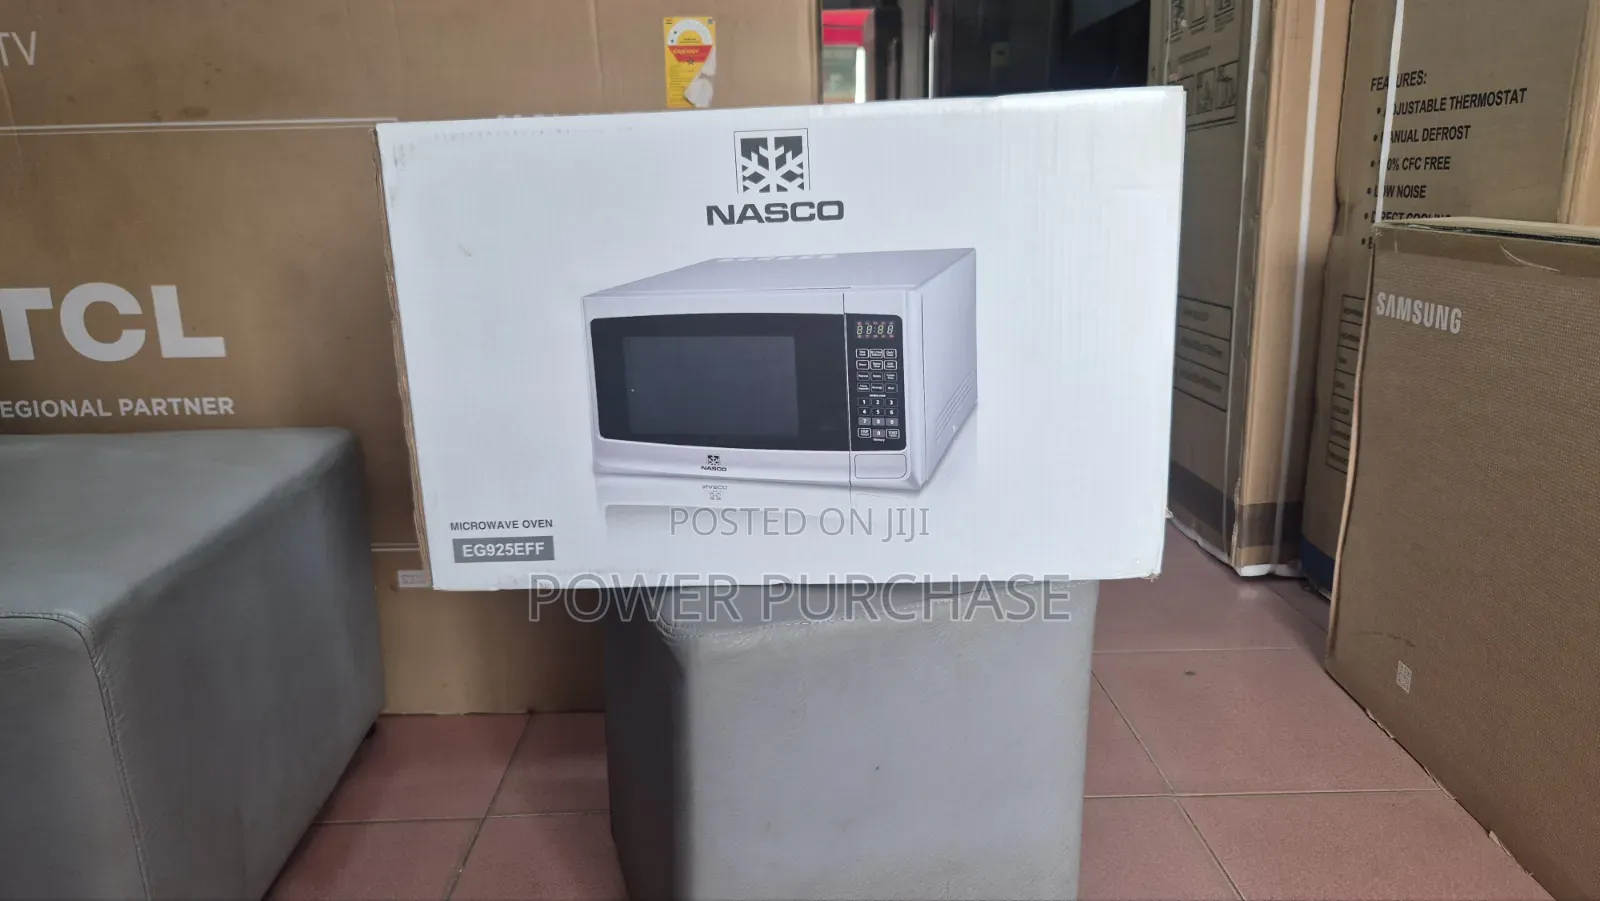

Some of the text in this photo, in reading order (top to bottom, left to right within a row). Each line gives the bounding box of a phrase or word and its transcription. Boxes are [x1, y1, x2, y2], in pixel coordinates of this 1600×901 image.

[1370, 70, 1427, 92] FEAURES:
[1450, 88, 1527, 111] THERMOSTAT
[1421, 125, 1471, 142] DEFROST
[1402, 157, 1422, 171] CFC
[1423, 156, 1451, 171] FREE
[1396, 185, 1426, 198] NOISE
[706, 200, 845, 226] NASCO
[0, 282, 226, 362] TCL
[1376, 292, 1462, 334] SAMSUNG
[118, 397, 235, 416] PARTNER
[450, 519, 553, 531] MICROWAVE OVEN
[462, 541, 545, 558] EG925EFF
